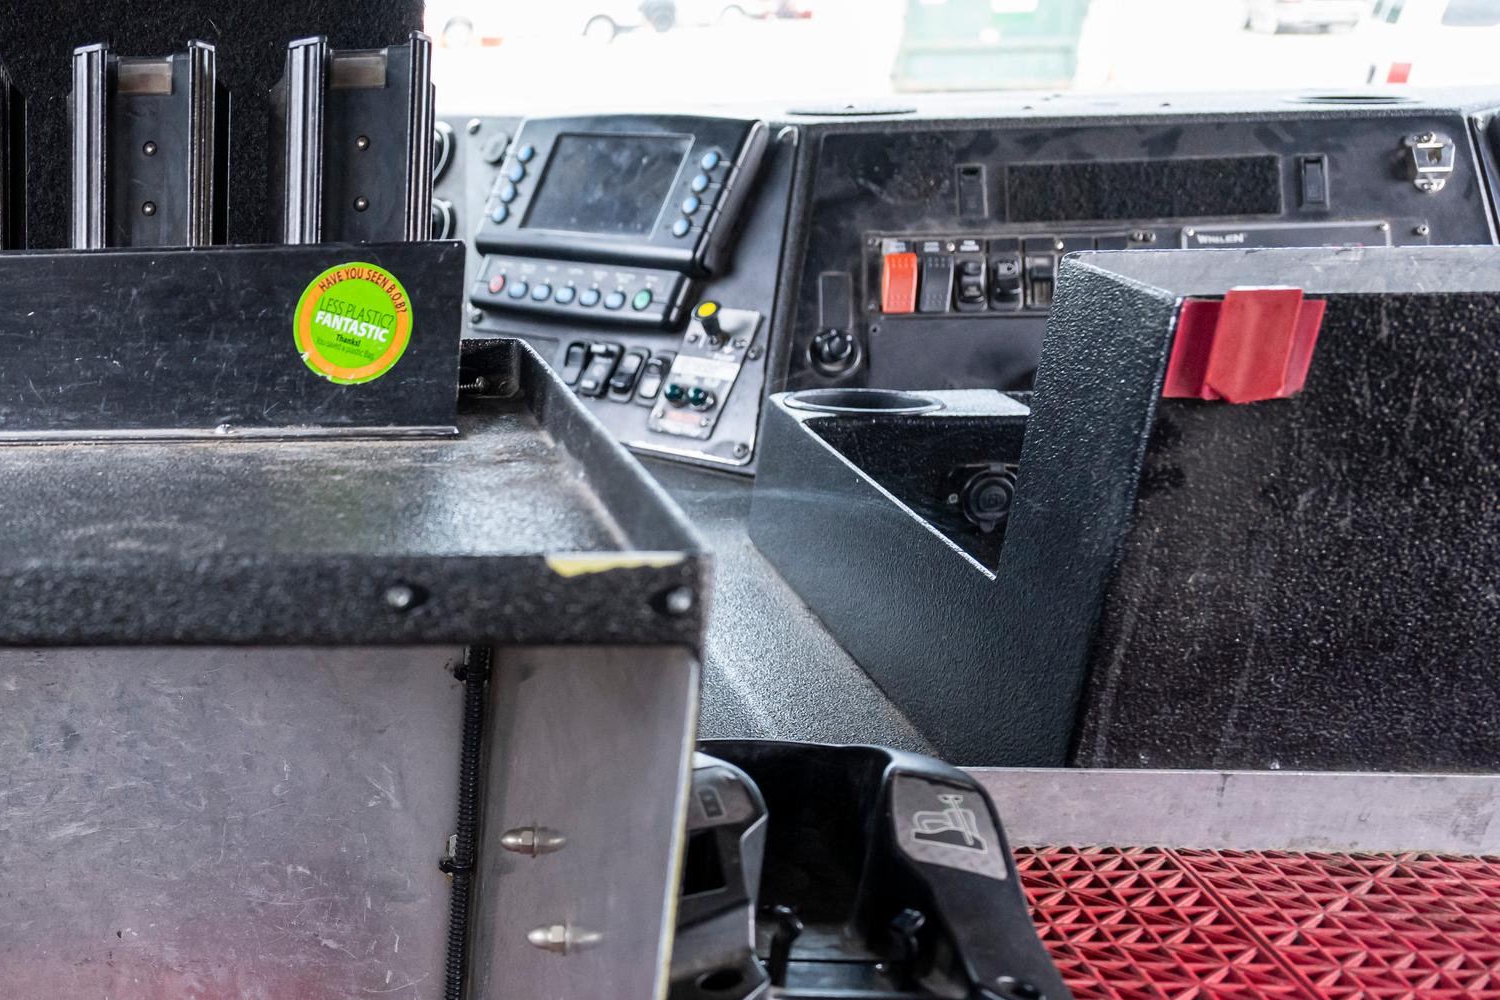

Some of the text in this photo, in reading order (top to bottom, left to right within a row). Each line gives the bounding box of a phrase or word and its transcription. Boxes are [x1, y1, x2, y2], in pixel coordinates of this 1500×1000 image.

[319, 271, 343, 292] HAVE
[345, 268, 364, 279] YOU
[366, 269, 389, 288] SEEN
[315, 310, 389, 343] FANTASTIC
[320, 297, 395, 329] LESS PLASTIC?
[336, 334, 362, 347] Thanks!
